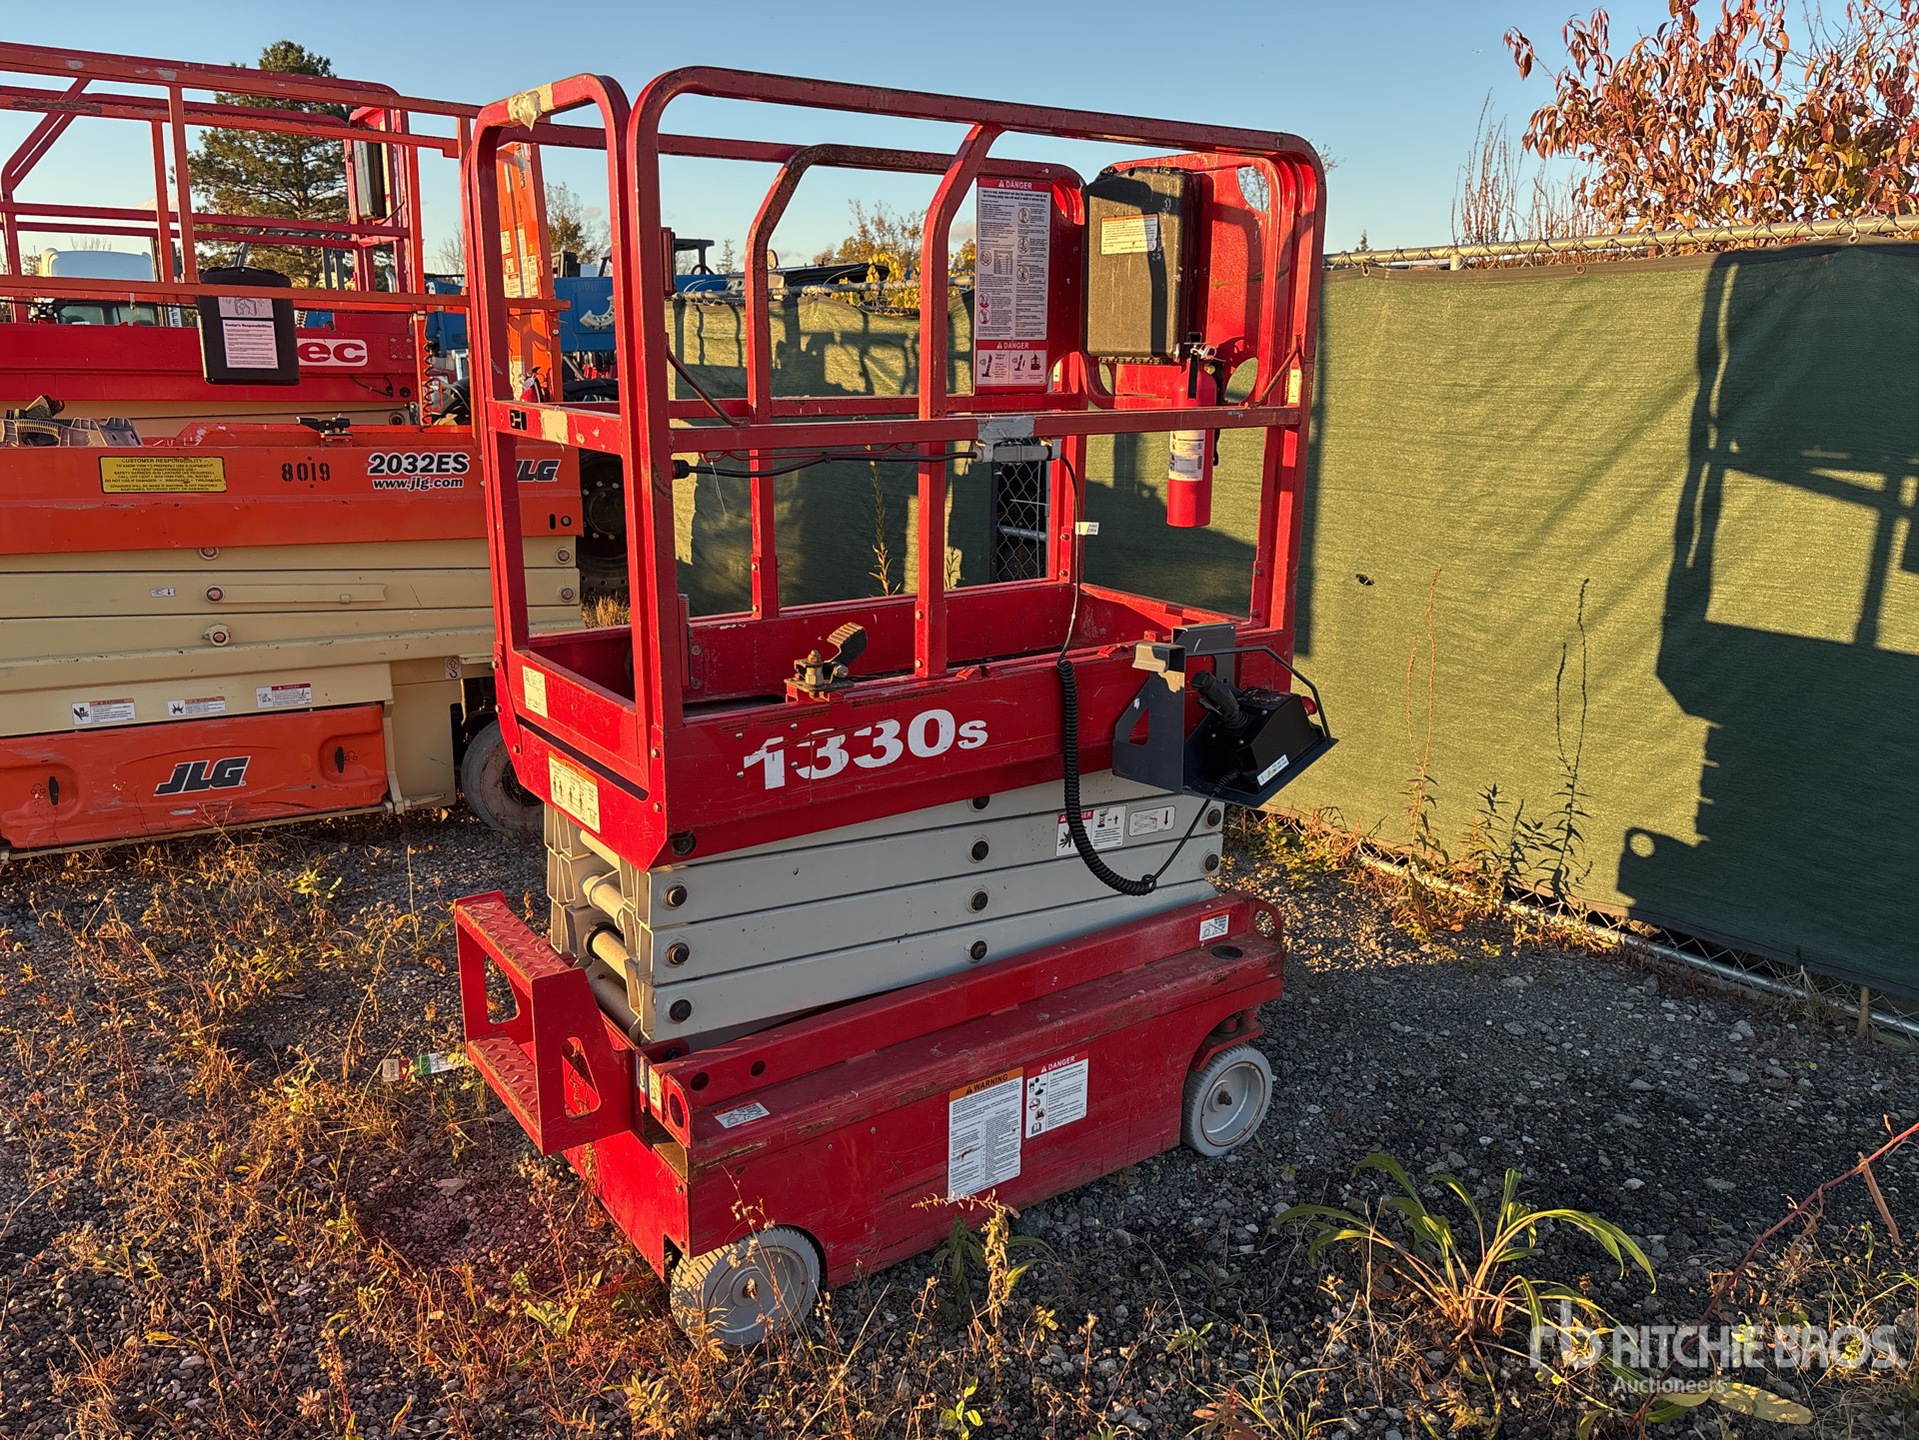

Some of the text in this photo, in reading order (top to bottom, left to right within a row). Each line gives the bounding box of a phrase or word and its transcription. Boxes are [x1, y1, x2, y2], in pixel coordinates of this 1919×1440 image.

[1005, 180, 1032, 190] DANGER
[297, 342, 366, 363] ec
[281, 463, 331, 482] 8019
[368, 453, 470, 475] 2032ES
[373, 477, 463, 490] www.jlg.com
[743, 709, 988, 790] 1330s
[153, 756, 251, 796] JLG
[1048, 1056, 1076, 1071] DANGER
[973, 1073, 1008, 1092] WARNING
